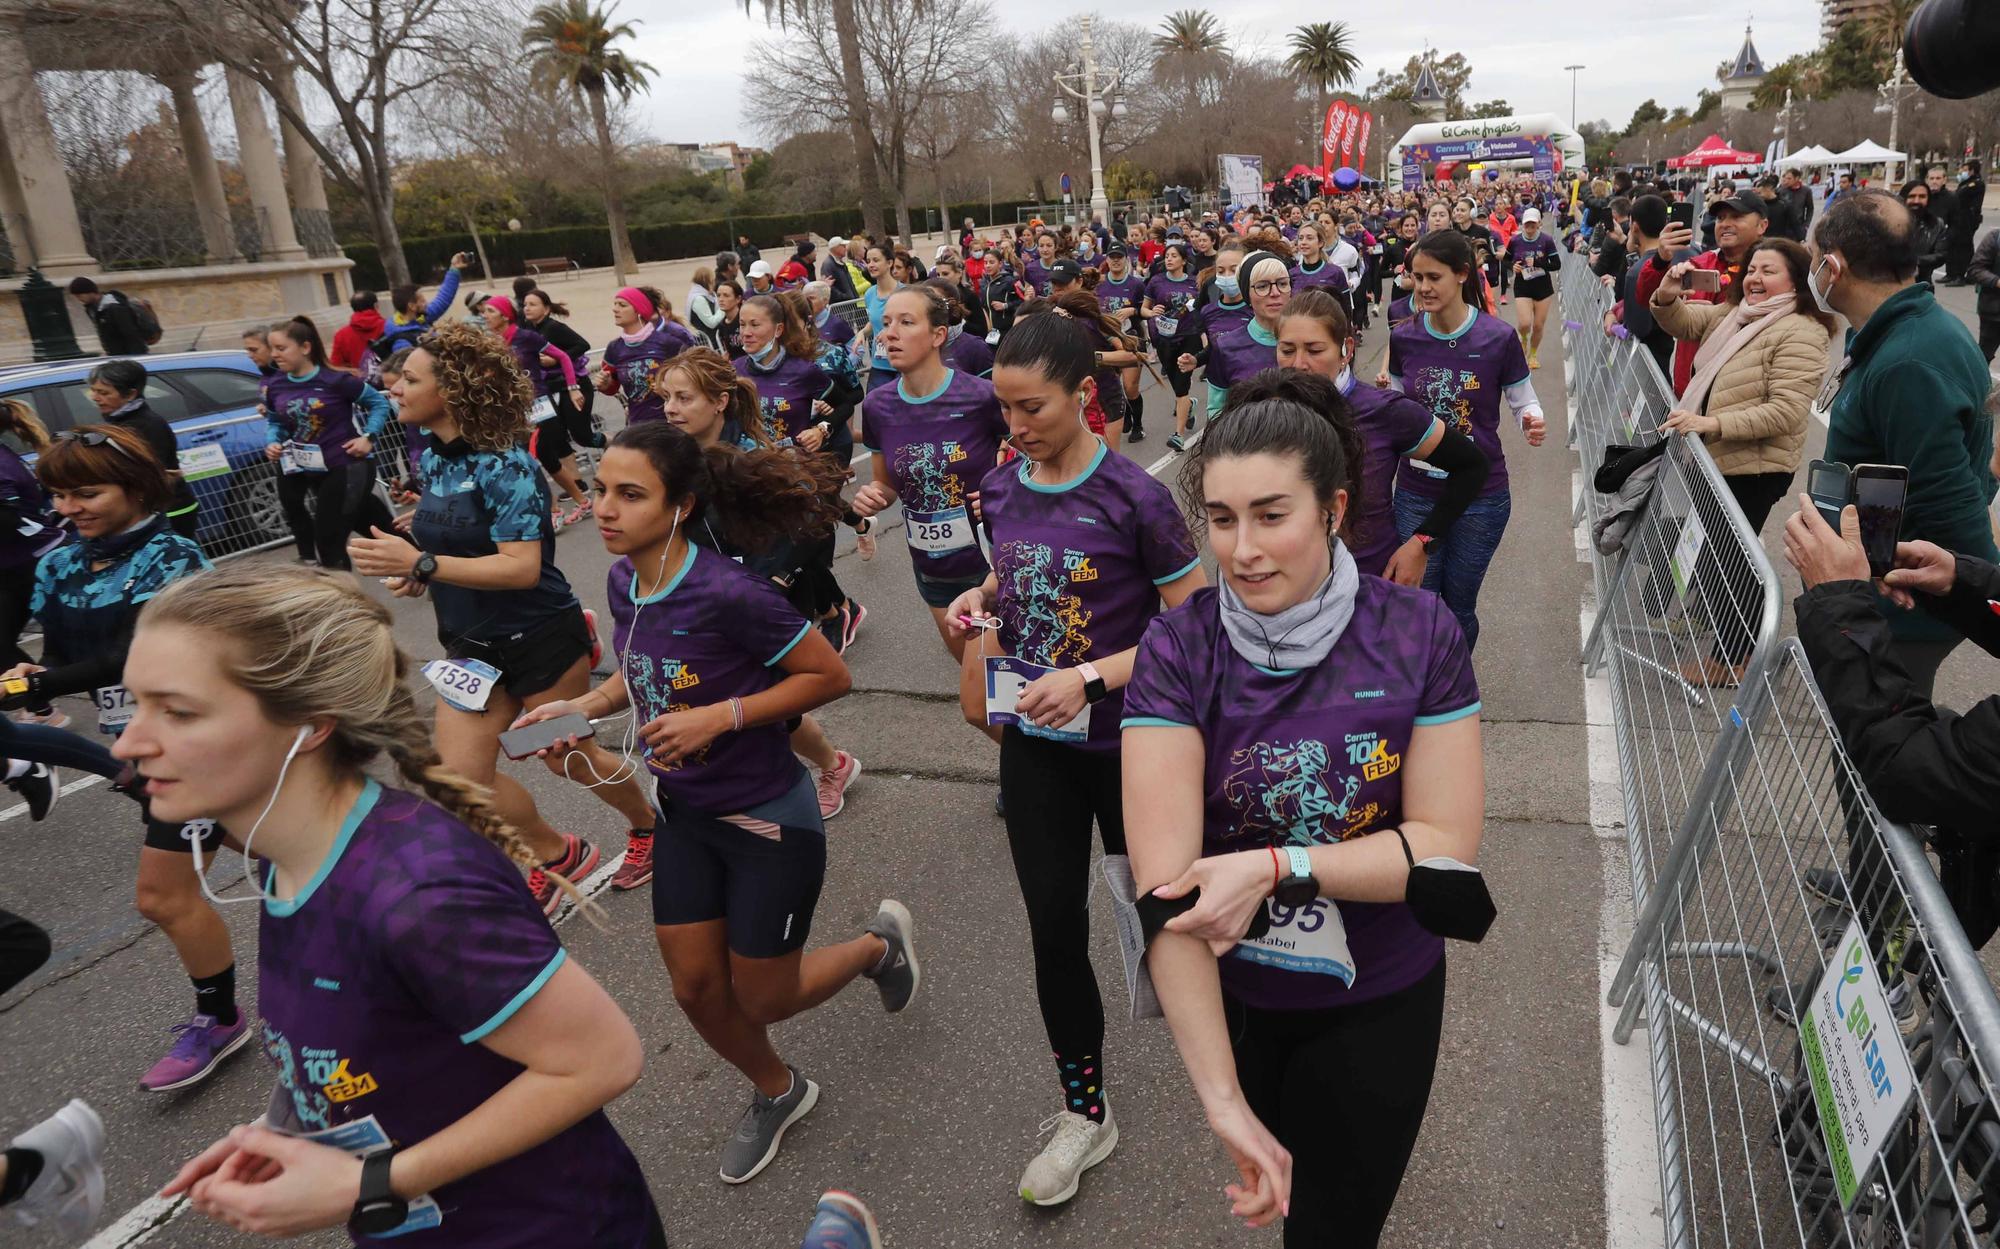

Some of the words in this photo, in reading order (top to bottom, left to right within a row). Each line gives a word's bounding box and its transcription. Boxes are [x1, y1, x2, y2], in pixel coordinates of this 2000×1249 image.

[1441, 126, 1453, 138] El
[1453, 123, 1480, 138] Corte
[1436, 145, 1465, 153] Carrera
[942, 444, 961, 455] 10K
[919, 523, 953, 540] 258
[1063, 555, 1090, 571] 10K
[1074, 571, 1095, 580] FEM
[435, 664, 482, 695] 1528
[662, 664, 688, 678] 10K
[675, 677, 696, 688] FEM
[1355, 690, 1386, 699] RUNNEK
[1344, 732, 1377, 743] Carrera
[1345, 739, 1388, 765] 10K
[1367, 757, 1398, 778] FEM
[1846, 994, 1893, 1099] geiser
[303, 1058, 350, 1085] 10K
[1822, 991, 1838, 1036] Alquiler
[1834, 1037, 1842, 1055] de
[1840, 1054, 1860, 1111] material
[1855, 1111, 1870, 1147] para
[330, 1078, 371, 1098] FEM
[1818, 1020, 1834, 1071] Eventos
[1831, 1068, 1855, 1145] Deportivos
[1818, 1067, 1828, 1092] 120
[1827, 1101, 1836, 1127] 609
[1834, 1128, 1844, 1154] 882
[1841, 1156, 1853, 1186] 815
